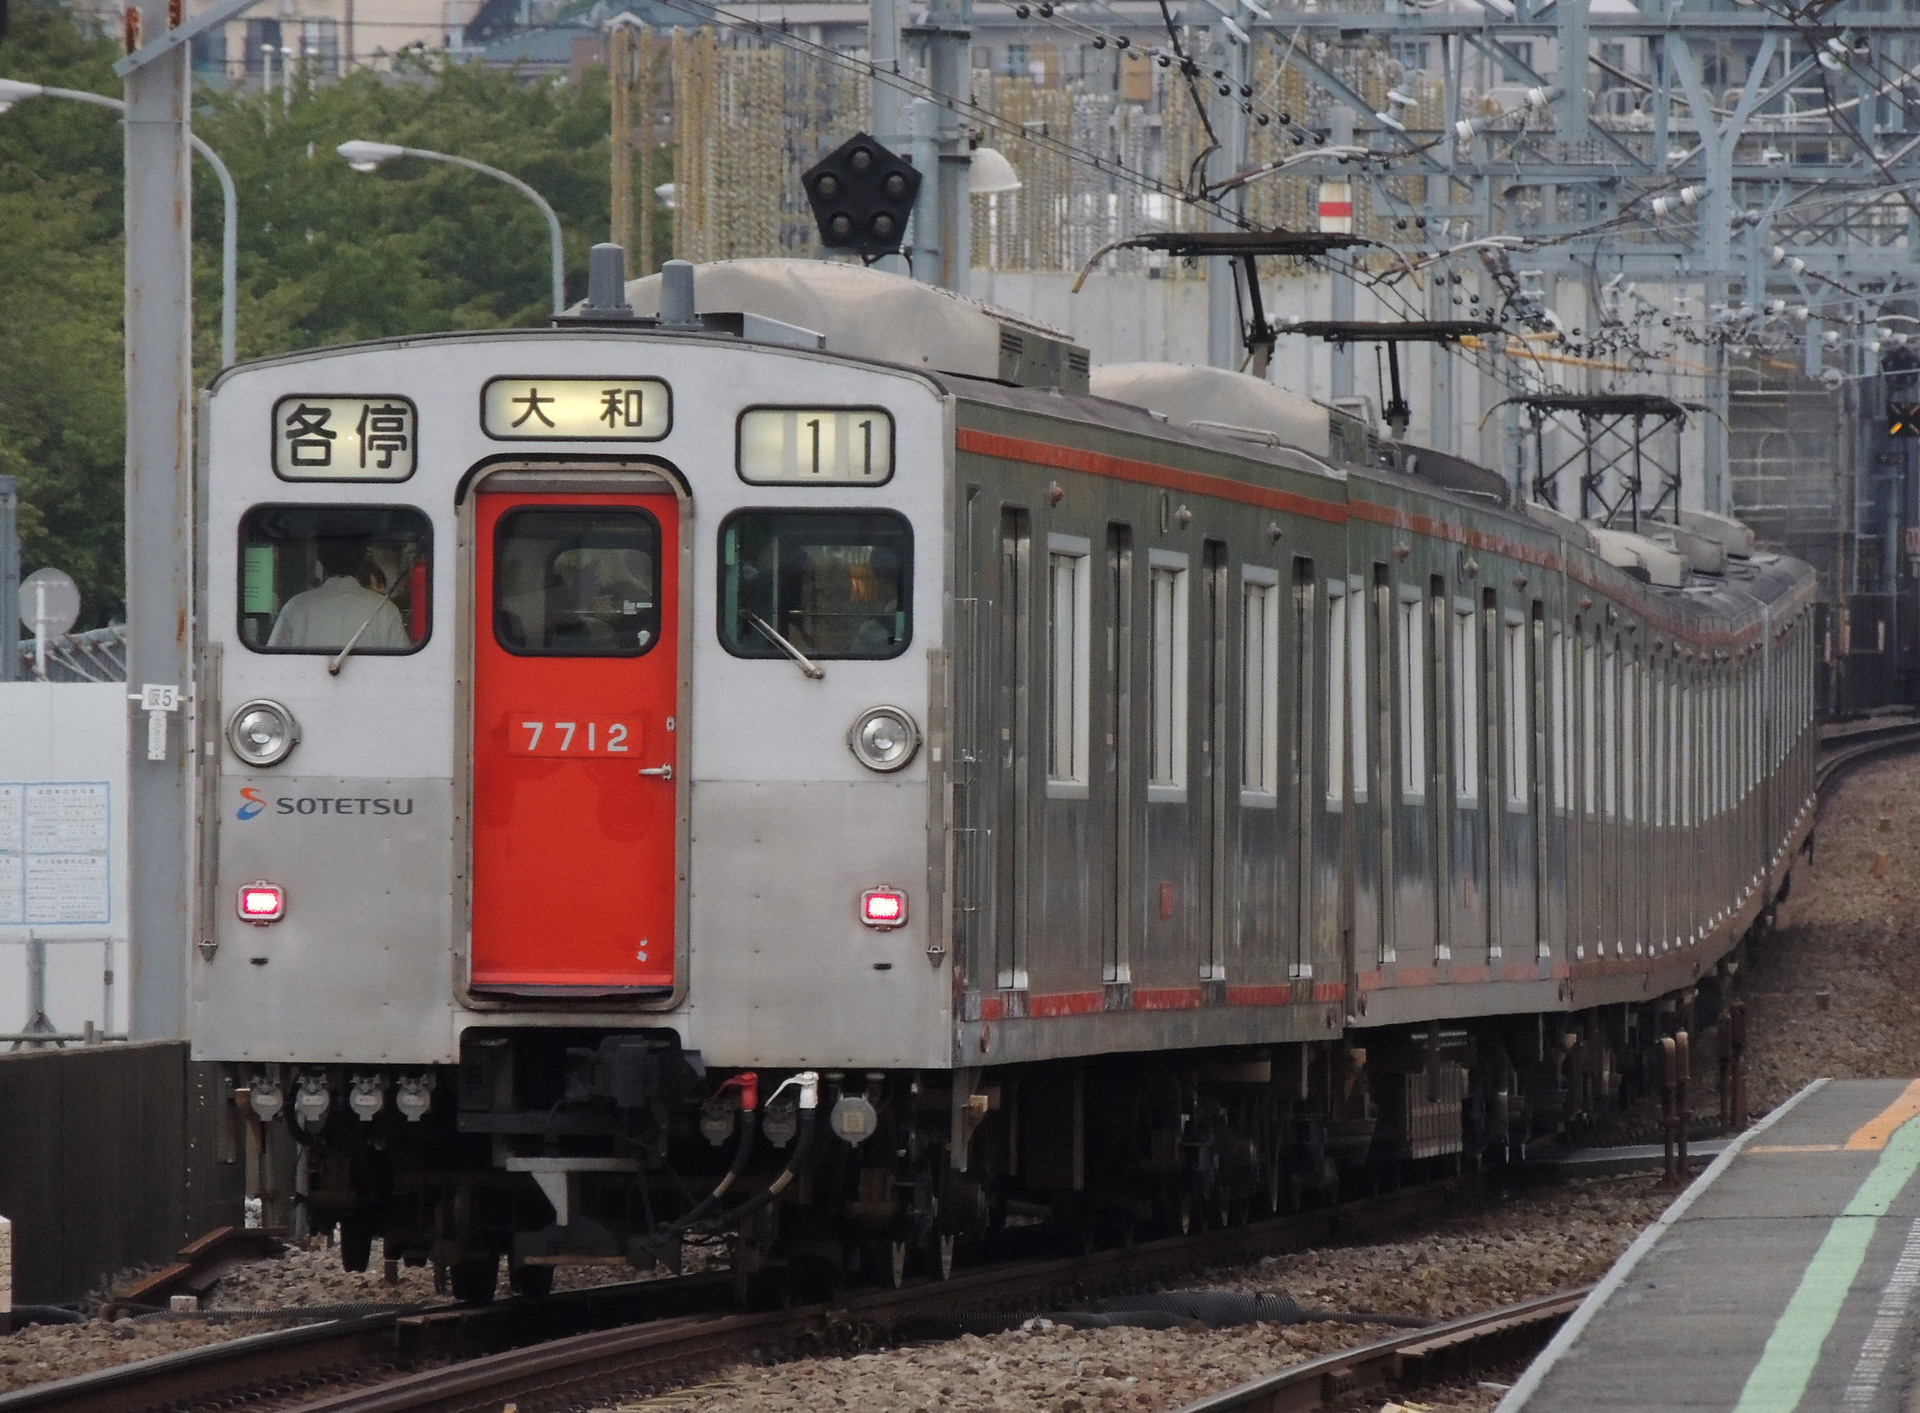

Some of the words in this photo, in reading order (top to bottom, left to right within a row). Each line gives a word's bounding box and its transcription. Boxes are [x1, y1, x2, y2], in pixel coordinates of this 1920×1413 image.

[512, 387, 643, 429] 大和
[285, 402, 408, 469] 各停
[806, 418, 872, 475] 11
[521, 721, 629, 752] 7712
[276, 797, 413, 815] SOTETSU
